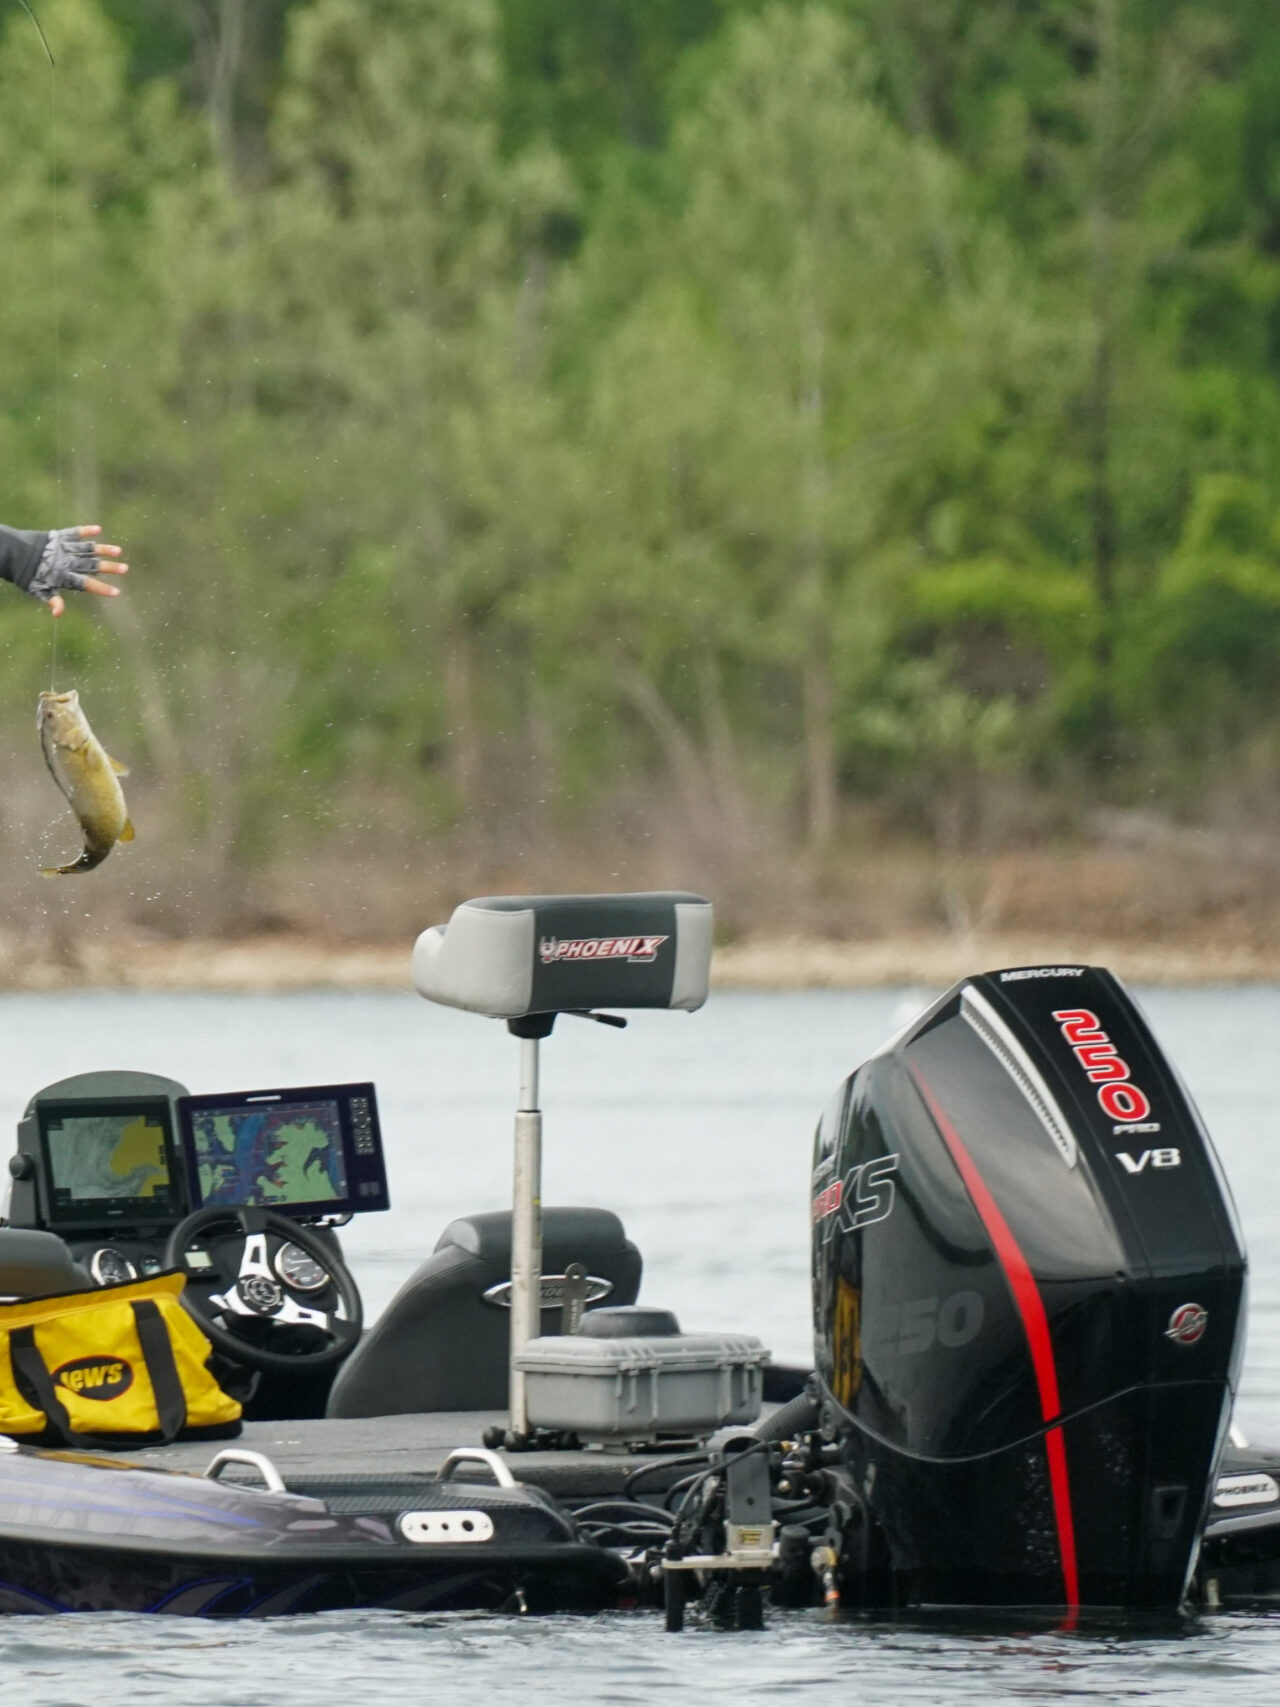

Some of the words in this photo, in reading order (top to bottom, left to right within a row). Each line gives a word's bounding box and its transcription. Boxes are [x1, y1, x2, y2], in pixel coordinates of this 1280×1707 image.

[555, 936, 665, 958] PHOENIX
[1000, 968, 1085, 983] MERCURY
[1051, 1008, 1151, 1122] 250
[1113, 1122, 1160, 1135] PRO
[1115, 1147, 1181, 1174] V8
